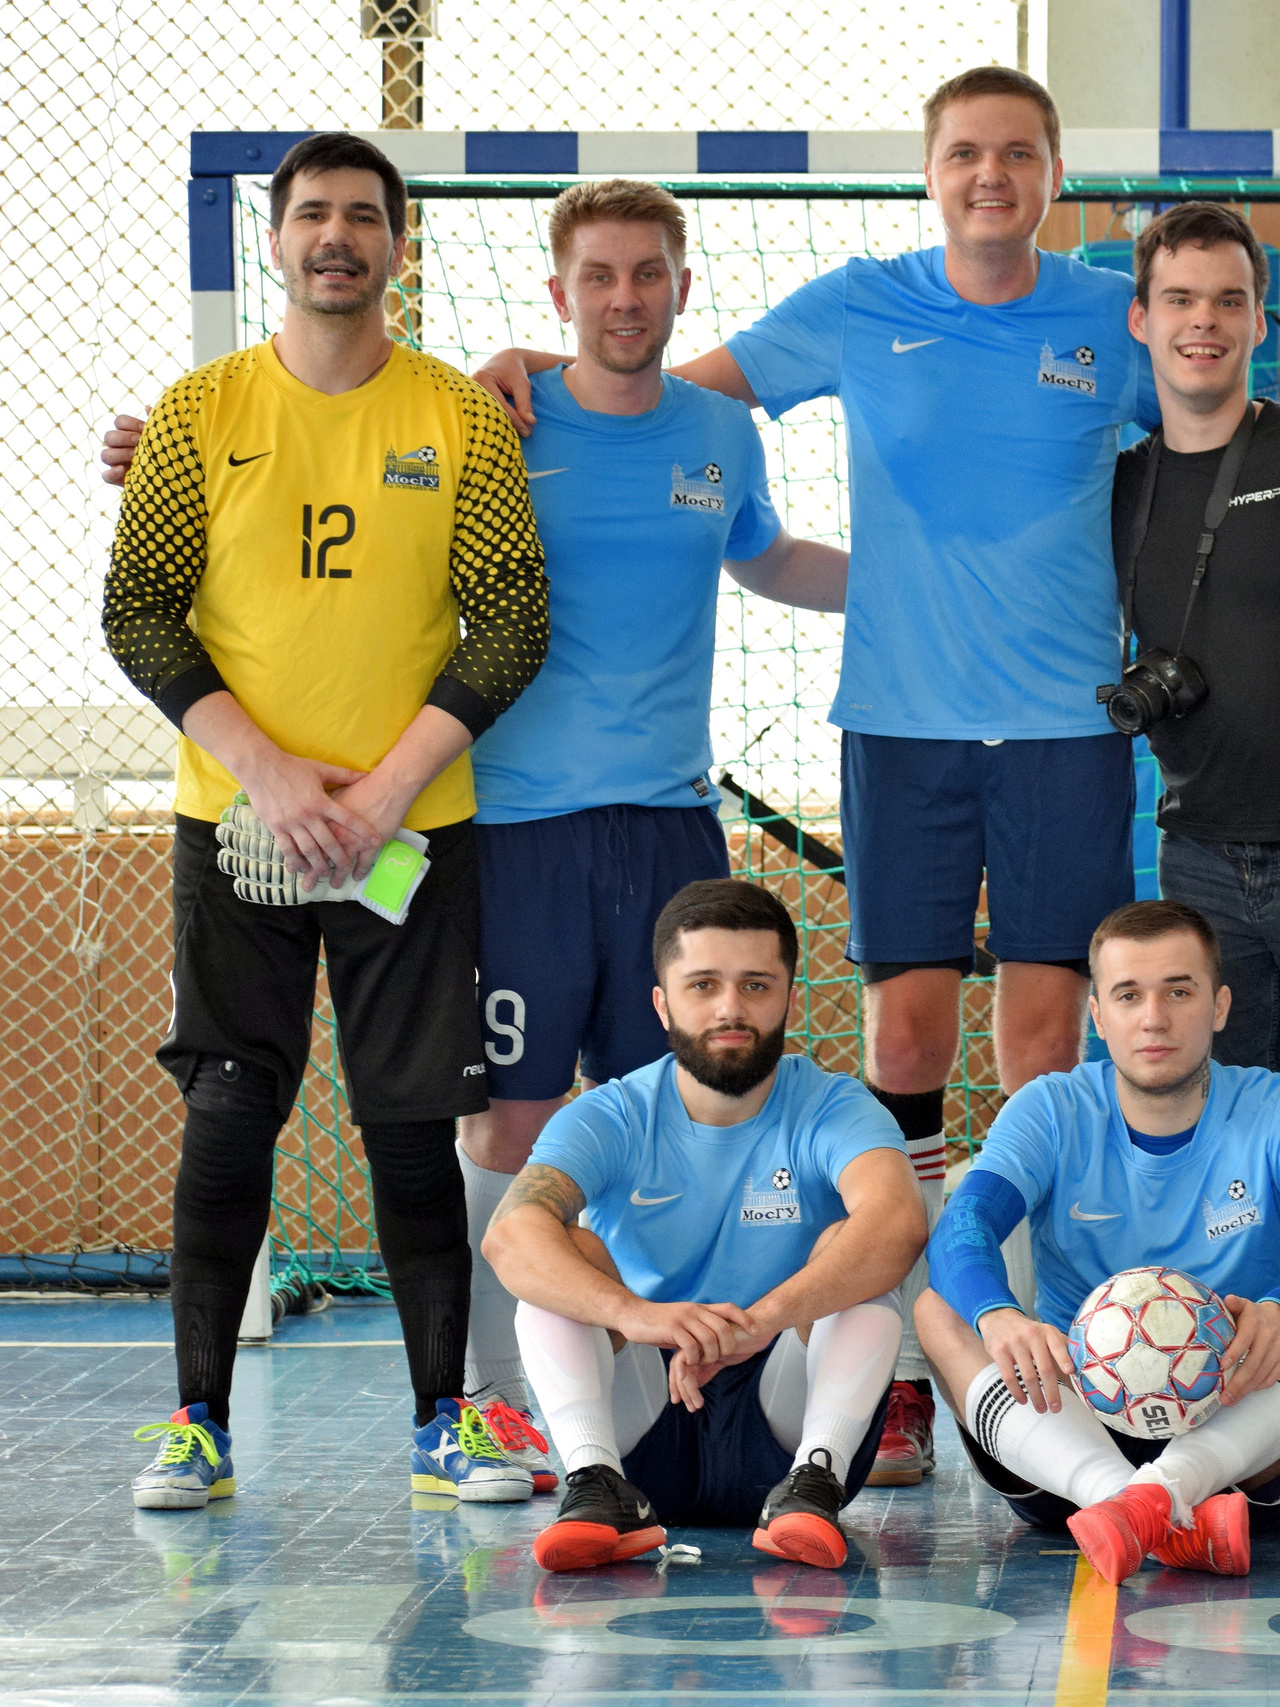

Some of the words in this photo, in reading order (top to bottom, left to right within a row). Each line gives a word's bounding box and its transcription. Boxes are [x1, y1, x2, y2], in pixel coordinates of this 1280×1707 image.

[1041, 372, 1095, 392] МосГУ
[385, 473, 438, 487] МосГУ
[673, 493, 723, 509] МосГУ
[301, 504, 356, 579] 12
[484, 989, 526, 1066] 9
[742, 1206, 798, 1221] МосГУ
[1207, 1209, 1257, 1239] МосГУ
